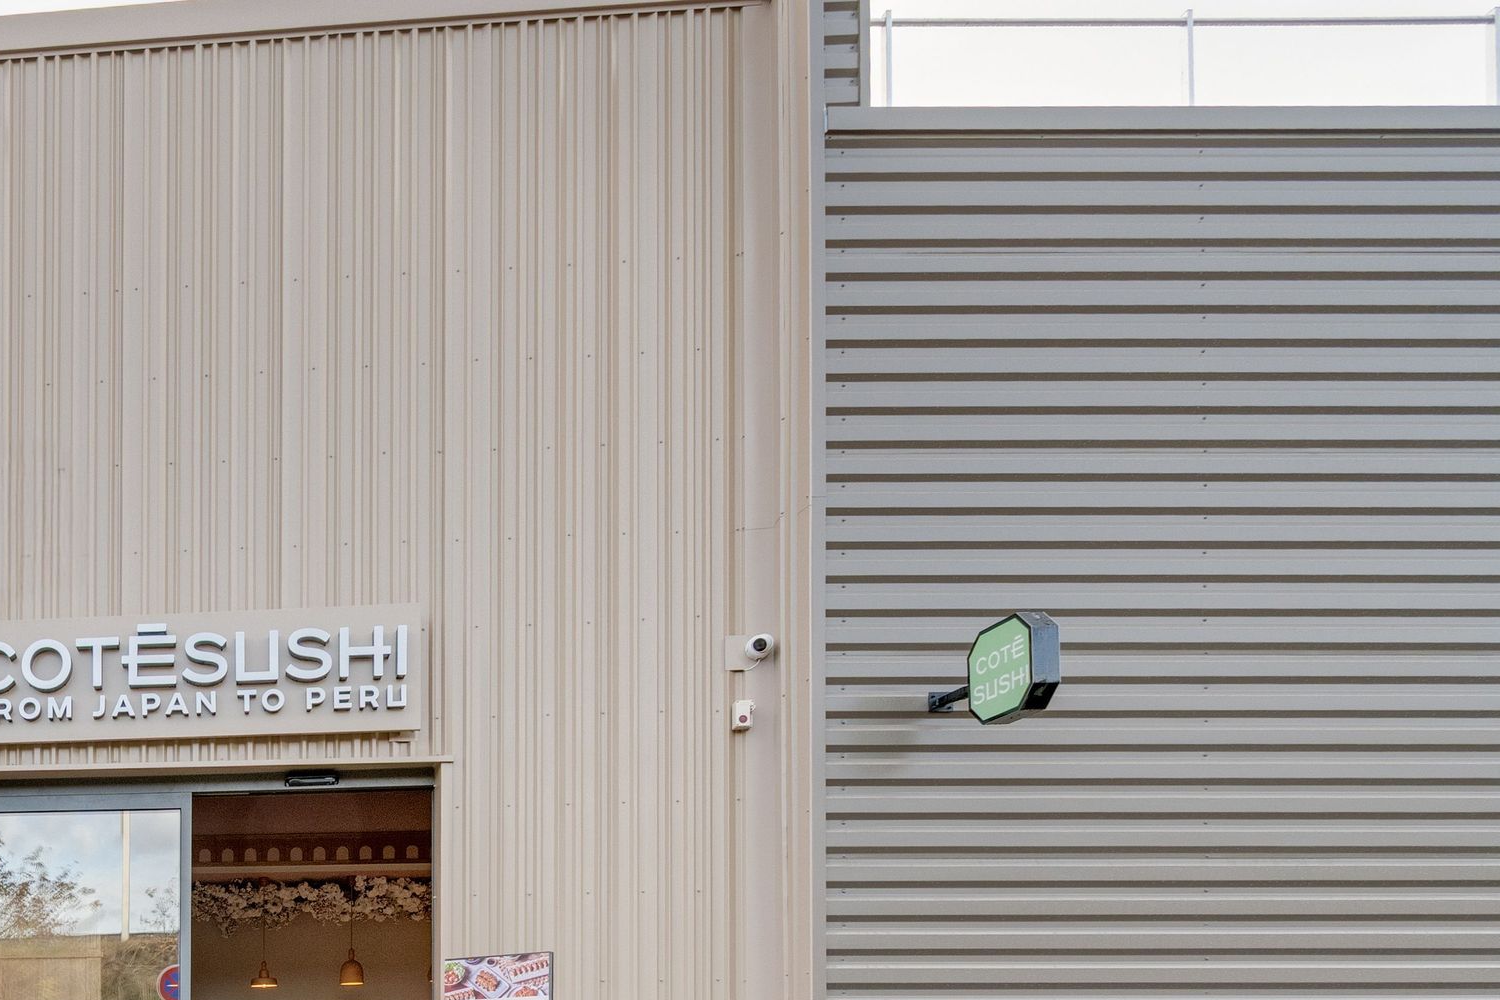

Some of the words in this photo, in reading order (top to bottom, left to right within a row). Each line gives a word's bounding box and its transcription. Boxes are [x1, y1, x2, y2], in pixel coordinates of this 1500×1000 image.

[92, 691, 218, 720] JAPAN
[236, 688, 286, 715] TO
[305, 684, 408, 713] PERU
[973, 664, 1029, 705] SUSHI
